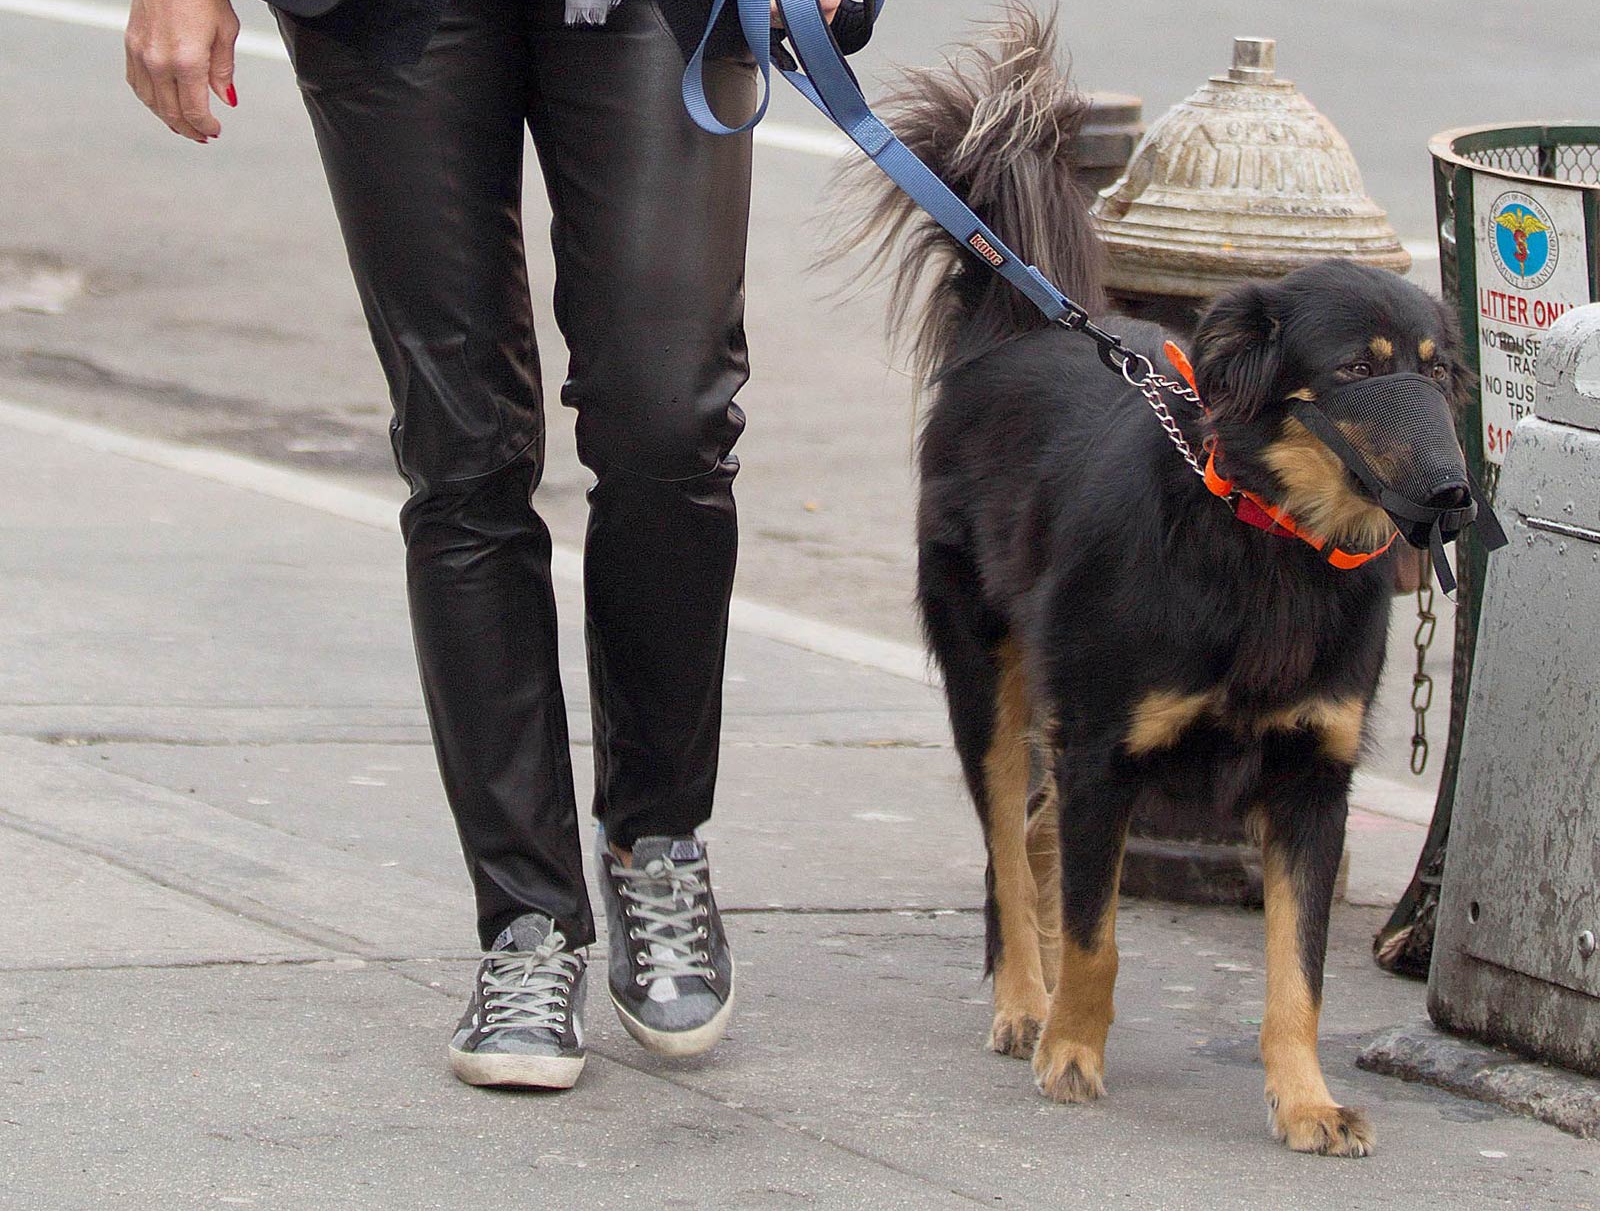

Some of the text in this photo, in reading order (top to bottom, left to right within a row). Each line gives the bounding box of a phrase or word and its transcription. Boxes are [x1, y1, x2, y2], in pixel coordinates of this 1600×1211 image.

[969, 233, 1004, 266] KONG
[1530, 230, 1556, 285] SANITATION
[1480, 288, 1528, 325] LITTER
[1481, 328, 1497, 348] NO
[1485, 374, 1535, 402] NO BUS
